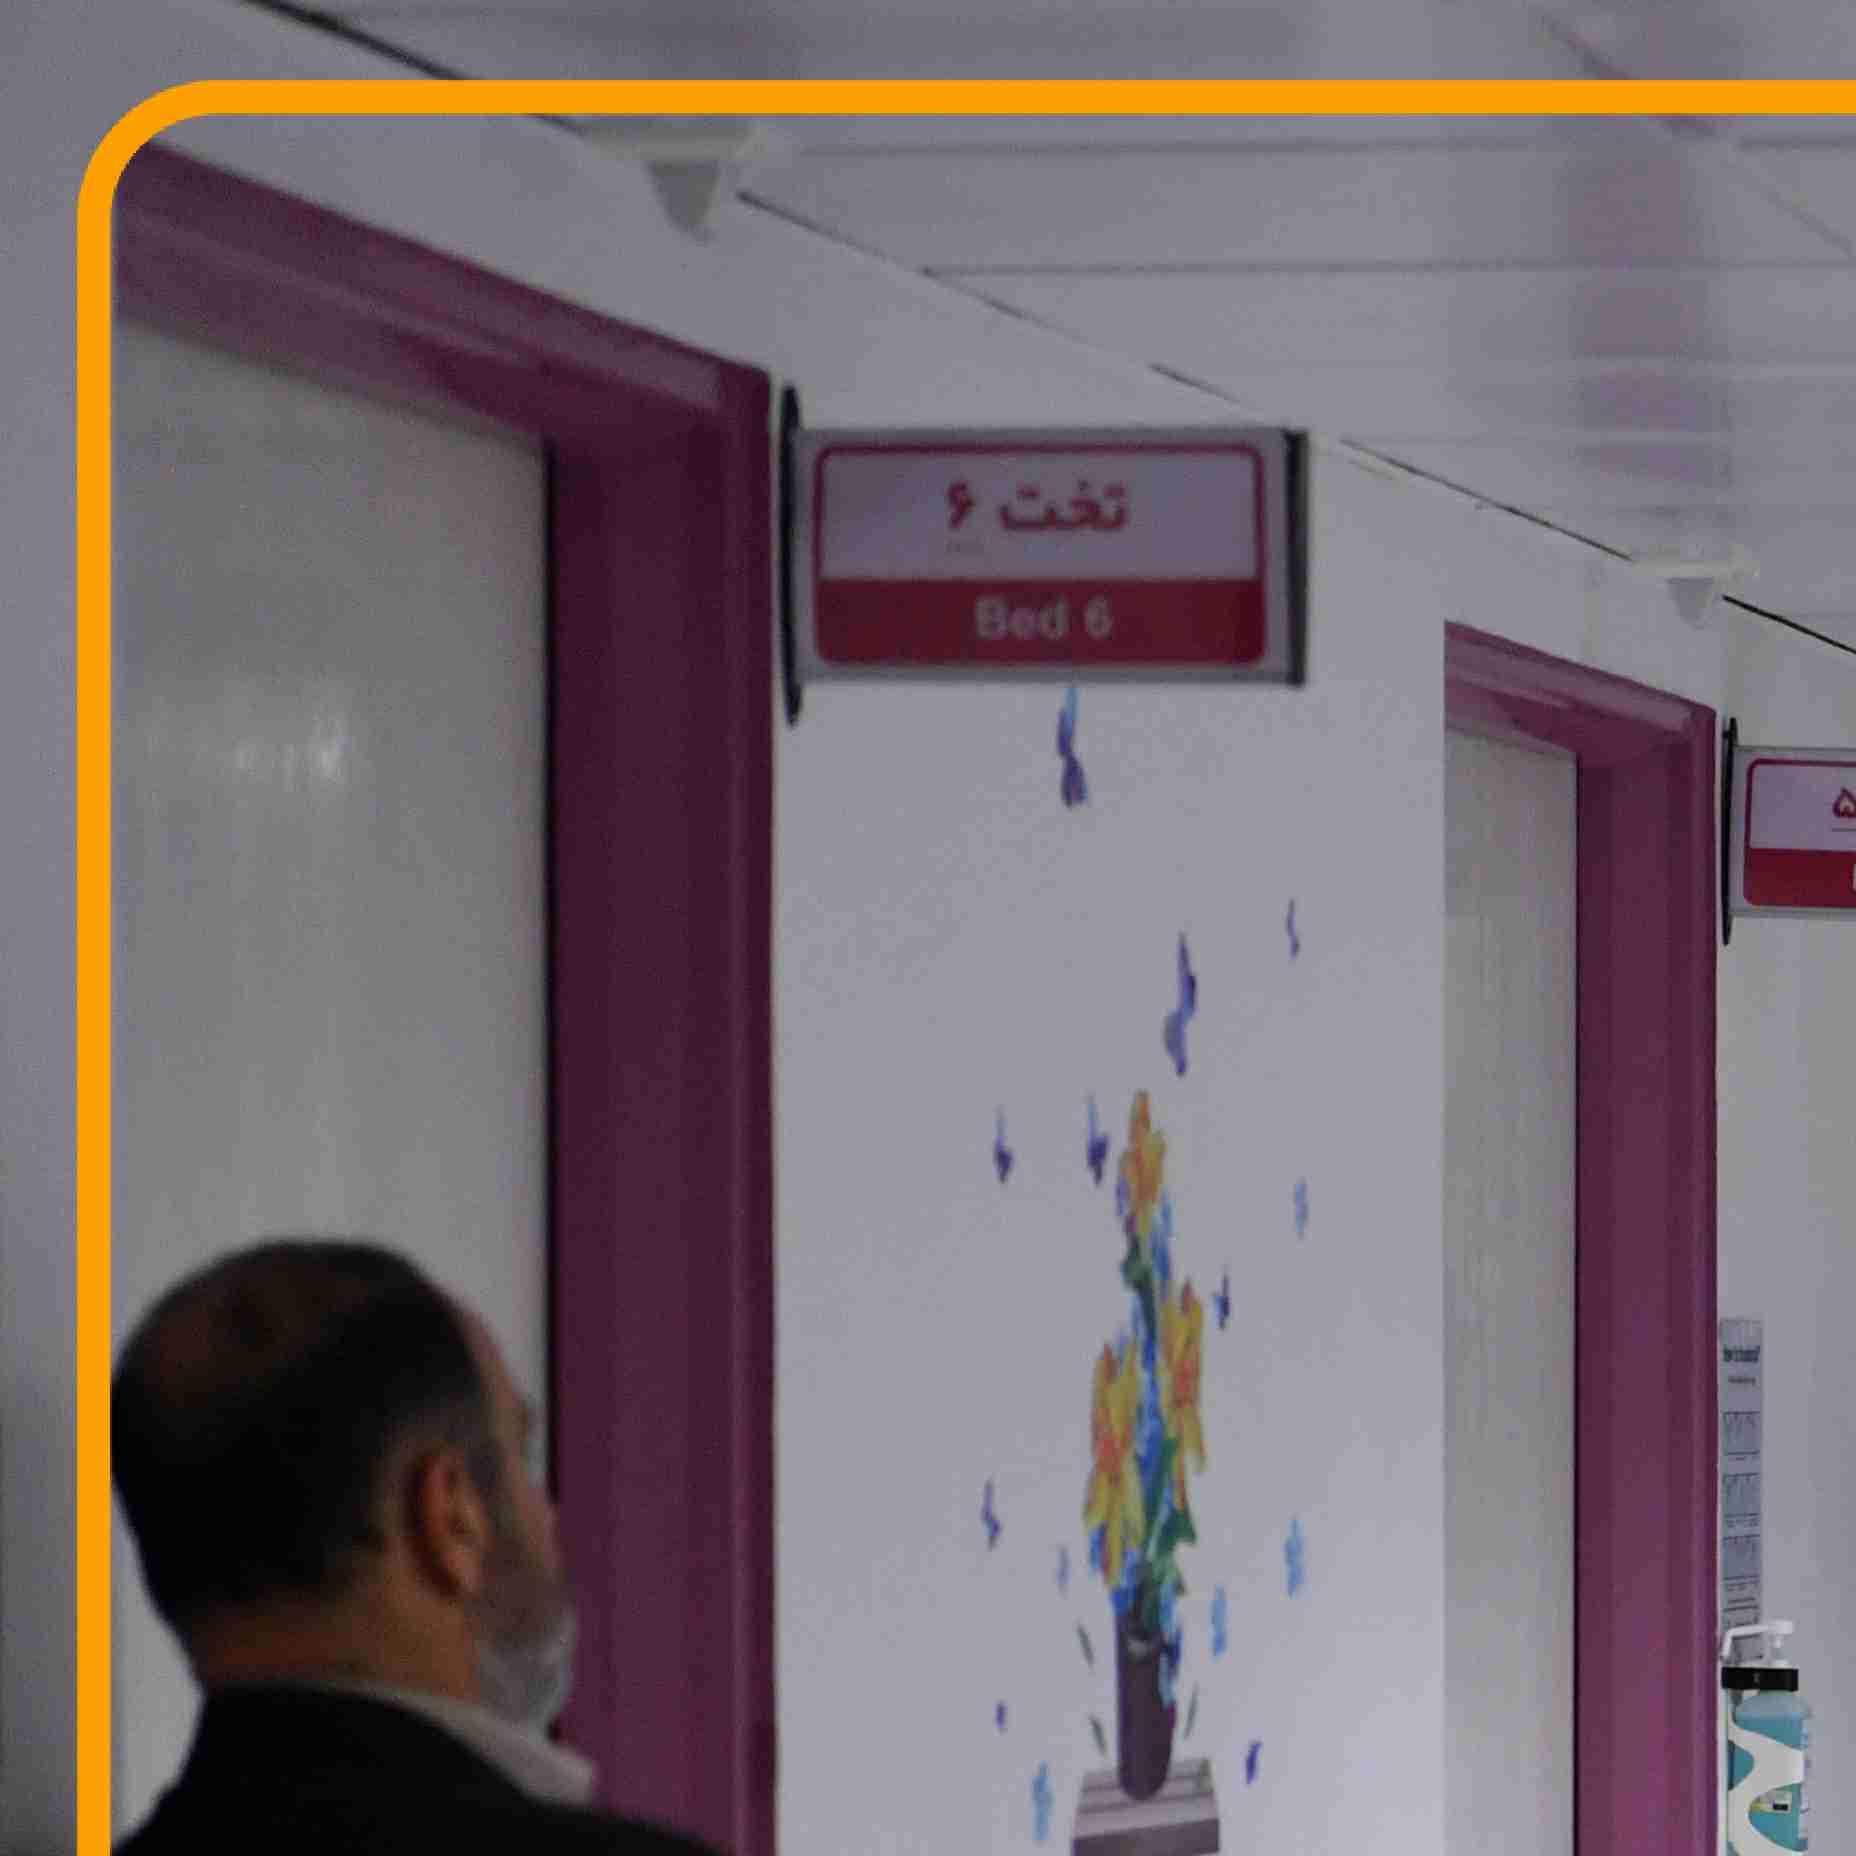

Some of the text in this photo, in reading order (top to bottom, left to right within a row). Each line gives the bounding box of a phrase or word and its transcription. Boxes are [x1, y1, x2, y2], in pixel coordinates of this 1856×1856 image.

[944, 479, 1130, 531] تخت ۶
[975, 596, 1113, 640] Bed 6
